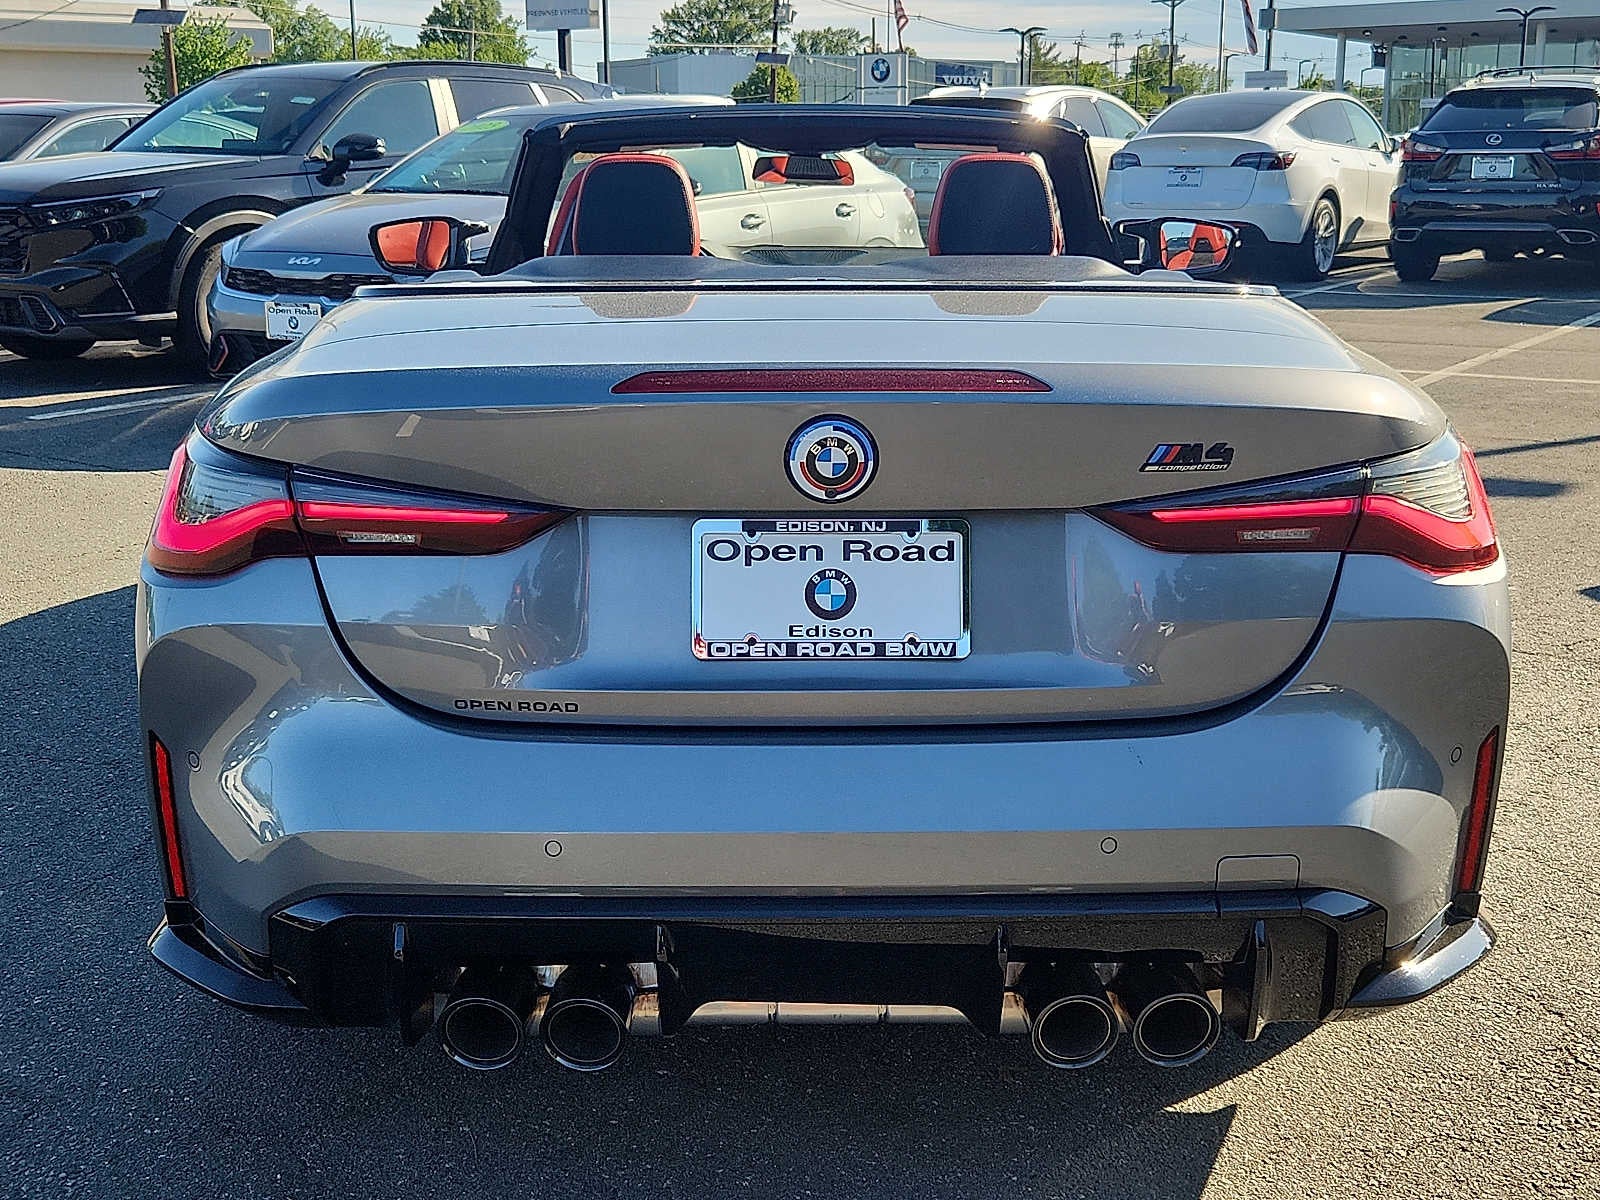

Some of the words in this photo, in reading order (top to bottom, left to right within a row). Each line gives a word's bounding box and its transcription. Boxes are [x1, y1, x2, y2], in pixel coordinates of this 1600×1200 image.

[942, 75, 988, 85] VOLV
[268, 306, 292, 316] Open
[294, 307, 319, 316] Road
[810, 437, 855, 456] BMW
[1158, 463, 1228, 472] competition
[775, 521, 854, 532] EDISON,
[861, 521, 887, 532] NJ
[706, 539, 824, 567] Open
[842, 539, 955, 562] Road
[811, 569, 852, 586] BMW
[788, 624, 874, 638] Edison
[710, 643, 787, 657] OPEN
[796, 642, 876, 657] ROAD
[885, 642, 954, 657] BMW
[454, 699, 513, 712] OPEN
[517, 701, 580, 713] ROAD
